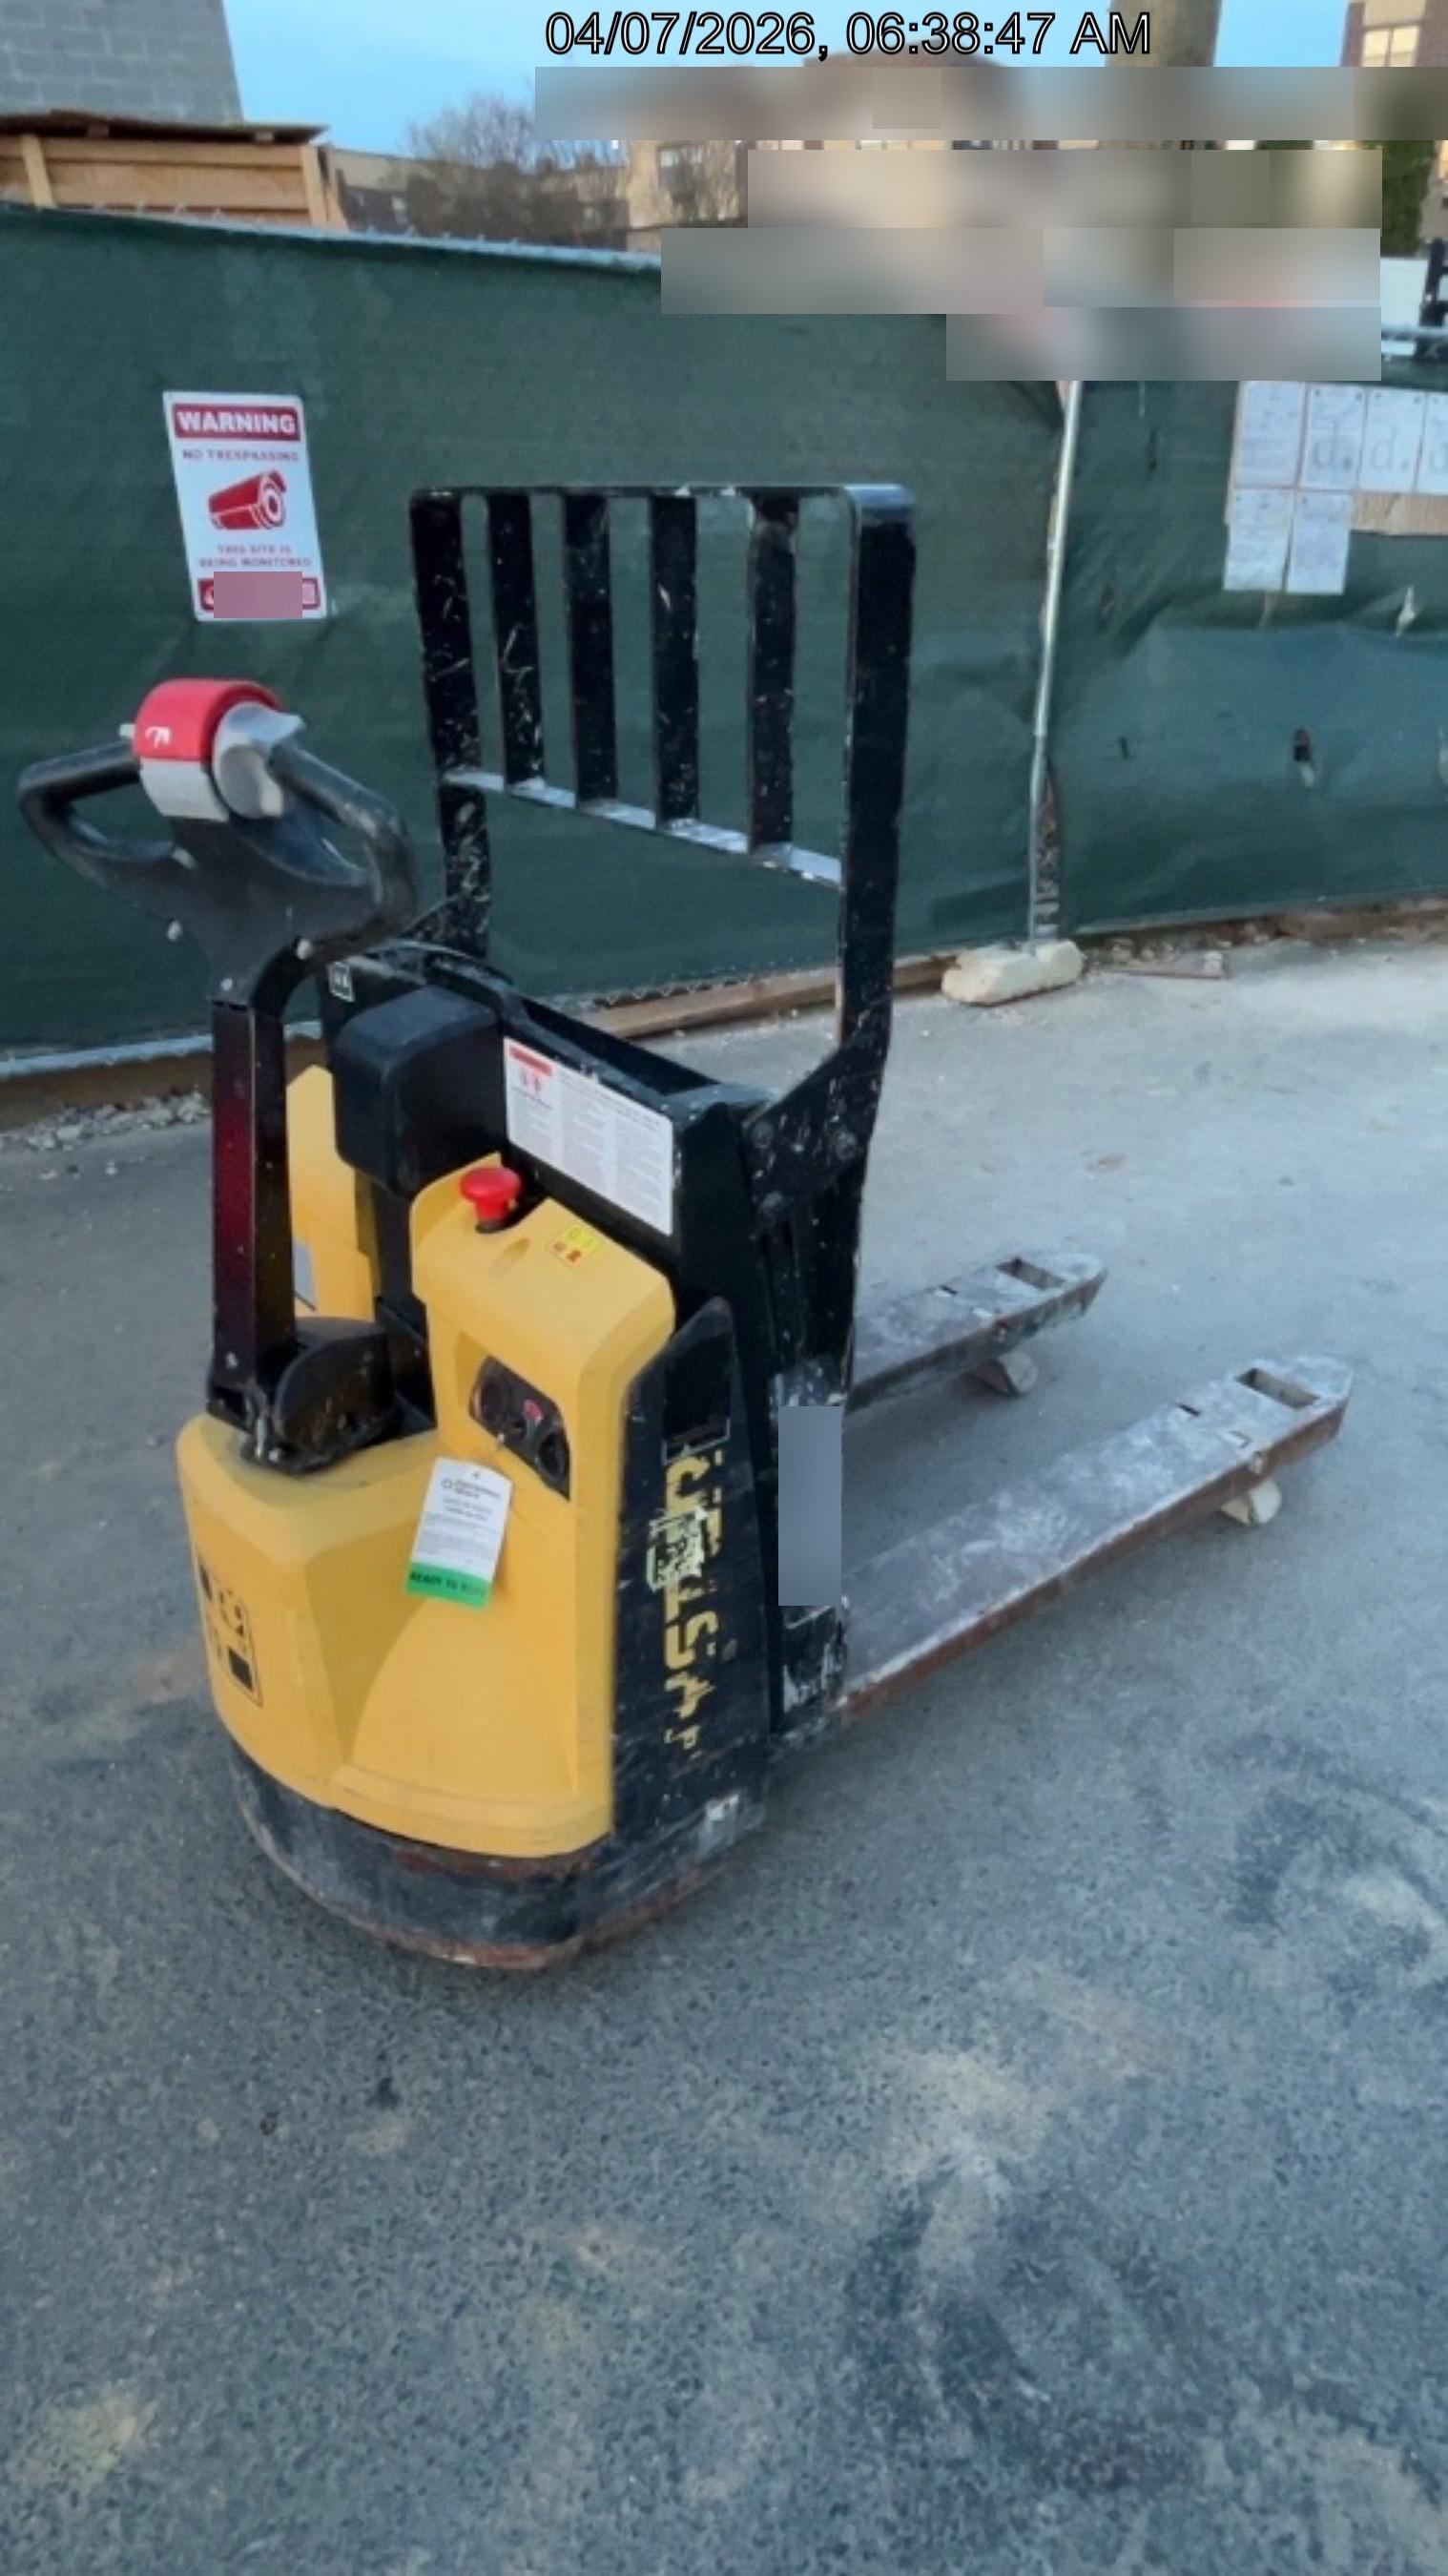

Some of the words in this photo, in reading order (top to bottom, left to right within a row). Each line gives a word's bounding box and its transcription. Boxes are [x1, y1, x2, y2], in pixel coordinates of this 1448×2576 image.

[177, 410, 296, 433] WARNING
[182, 449, 203, 461] NO
[208, 449, 300, 461] TRESPASSING
[217, 544, 246, 554] THIS
[250, 544, 276, 553] SITE
[279, 545, 292, 554] IS
[199, 558, 238, 568] BEING
[240, 558, 312, 568] MONITORED
